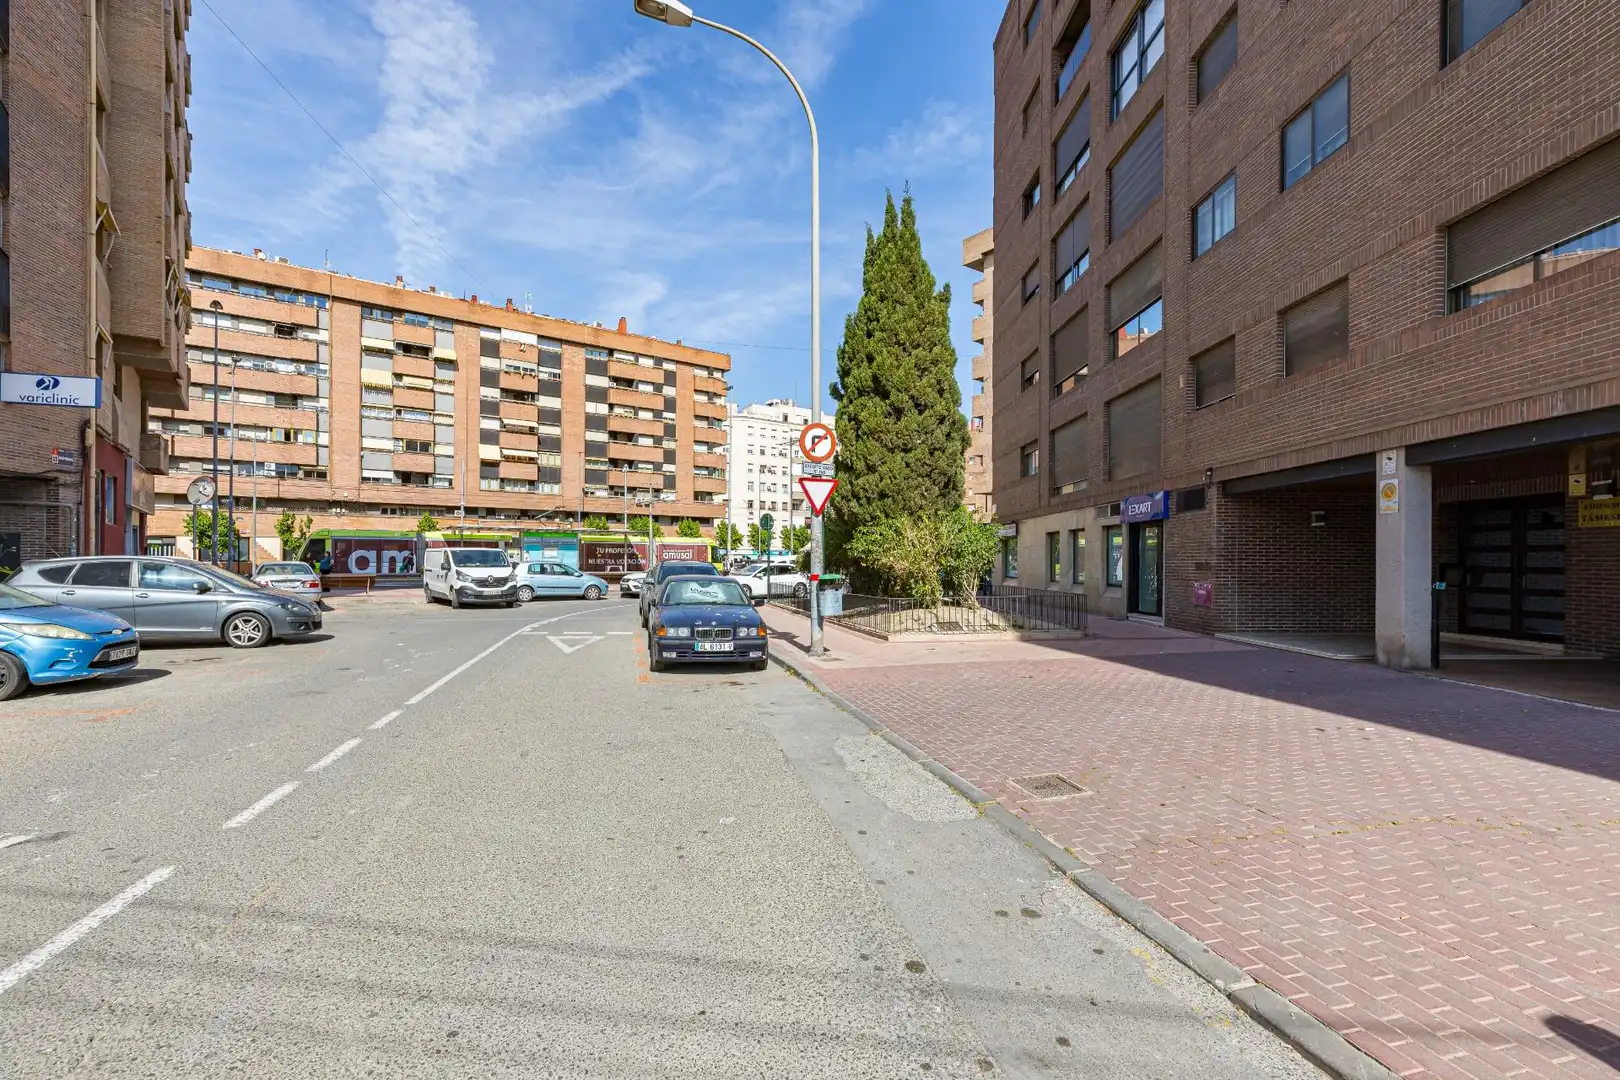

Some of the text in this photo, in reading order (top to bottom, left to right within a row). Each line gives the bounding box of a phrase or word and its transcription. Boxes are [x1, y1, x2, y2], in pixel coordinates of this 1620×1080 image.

[19, 393, 80, 405] variclinic
[1128, 501, 1152, 515] LEXART
[663, 549, 693, 559] amusal
[616, 557, 646, 565] VOACIÓN
[709, 643, 726, 651] 6131
